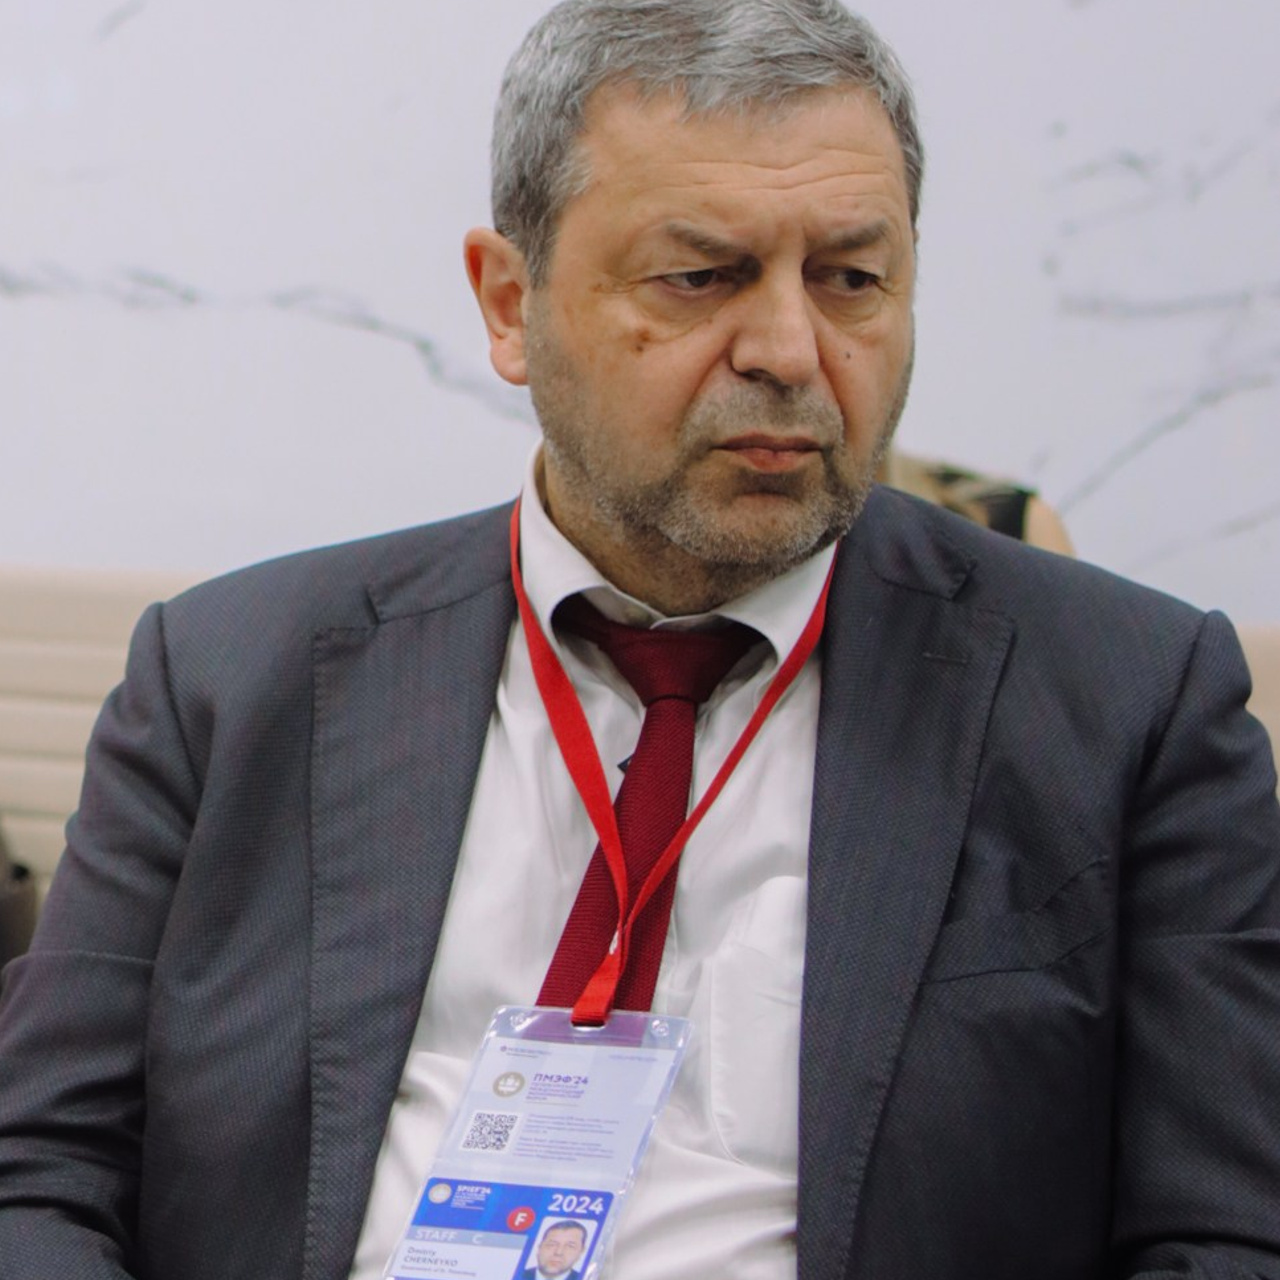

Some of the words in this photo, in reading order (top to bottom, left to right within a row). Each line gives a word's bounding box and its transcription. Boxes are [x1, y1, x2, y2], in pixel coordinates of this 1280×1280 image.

[547, 1193, 604, 1215] 2024
[514, 1212, 527, 1227] F
[415, 1229, 458, 1242] STAFF
[472, 1234, 483, 1244] C
